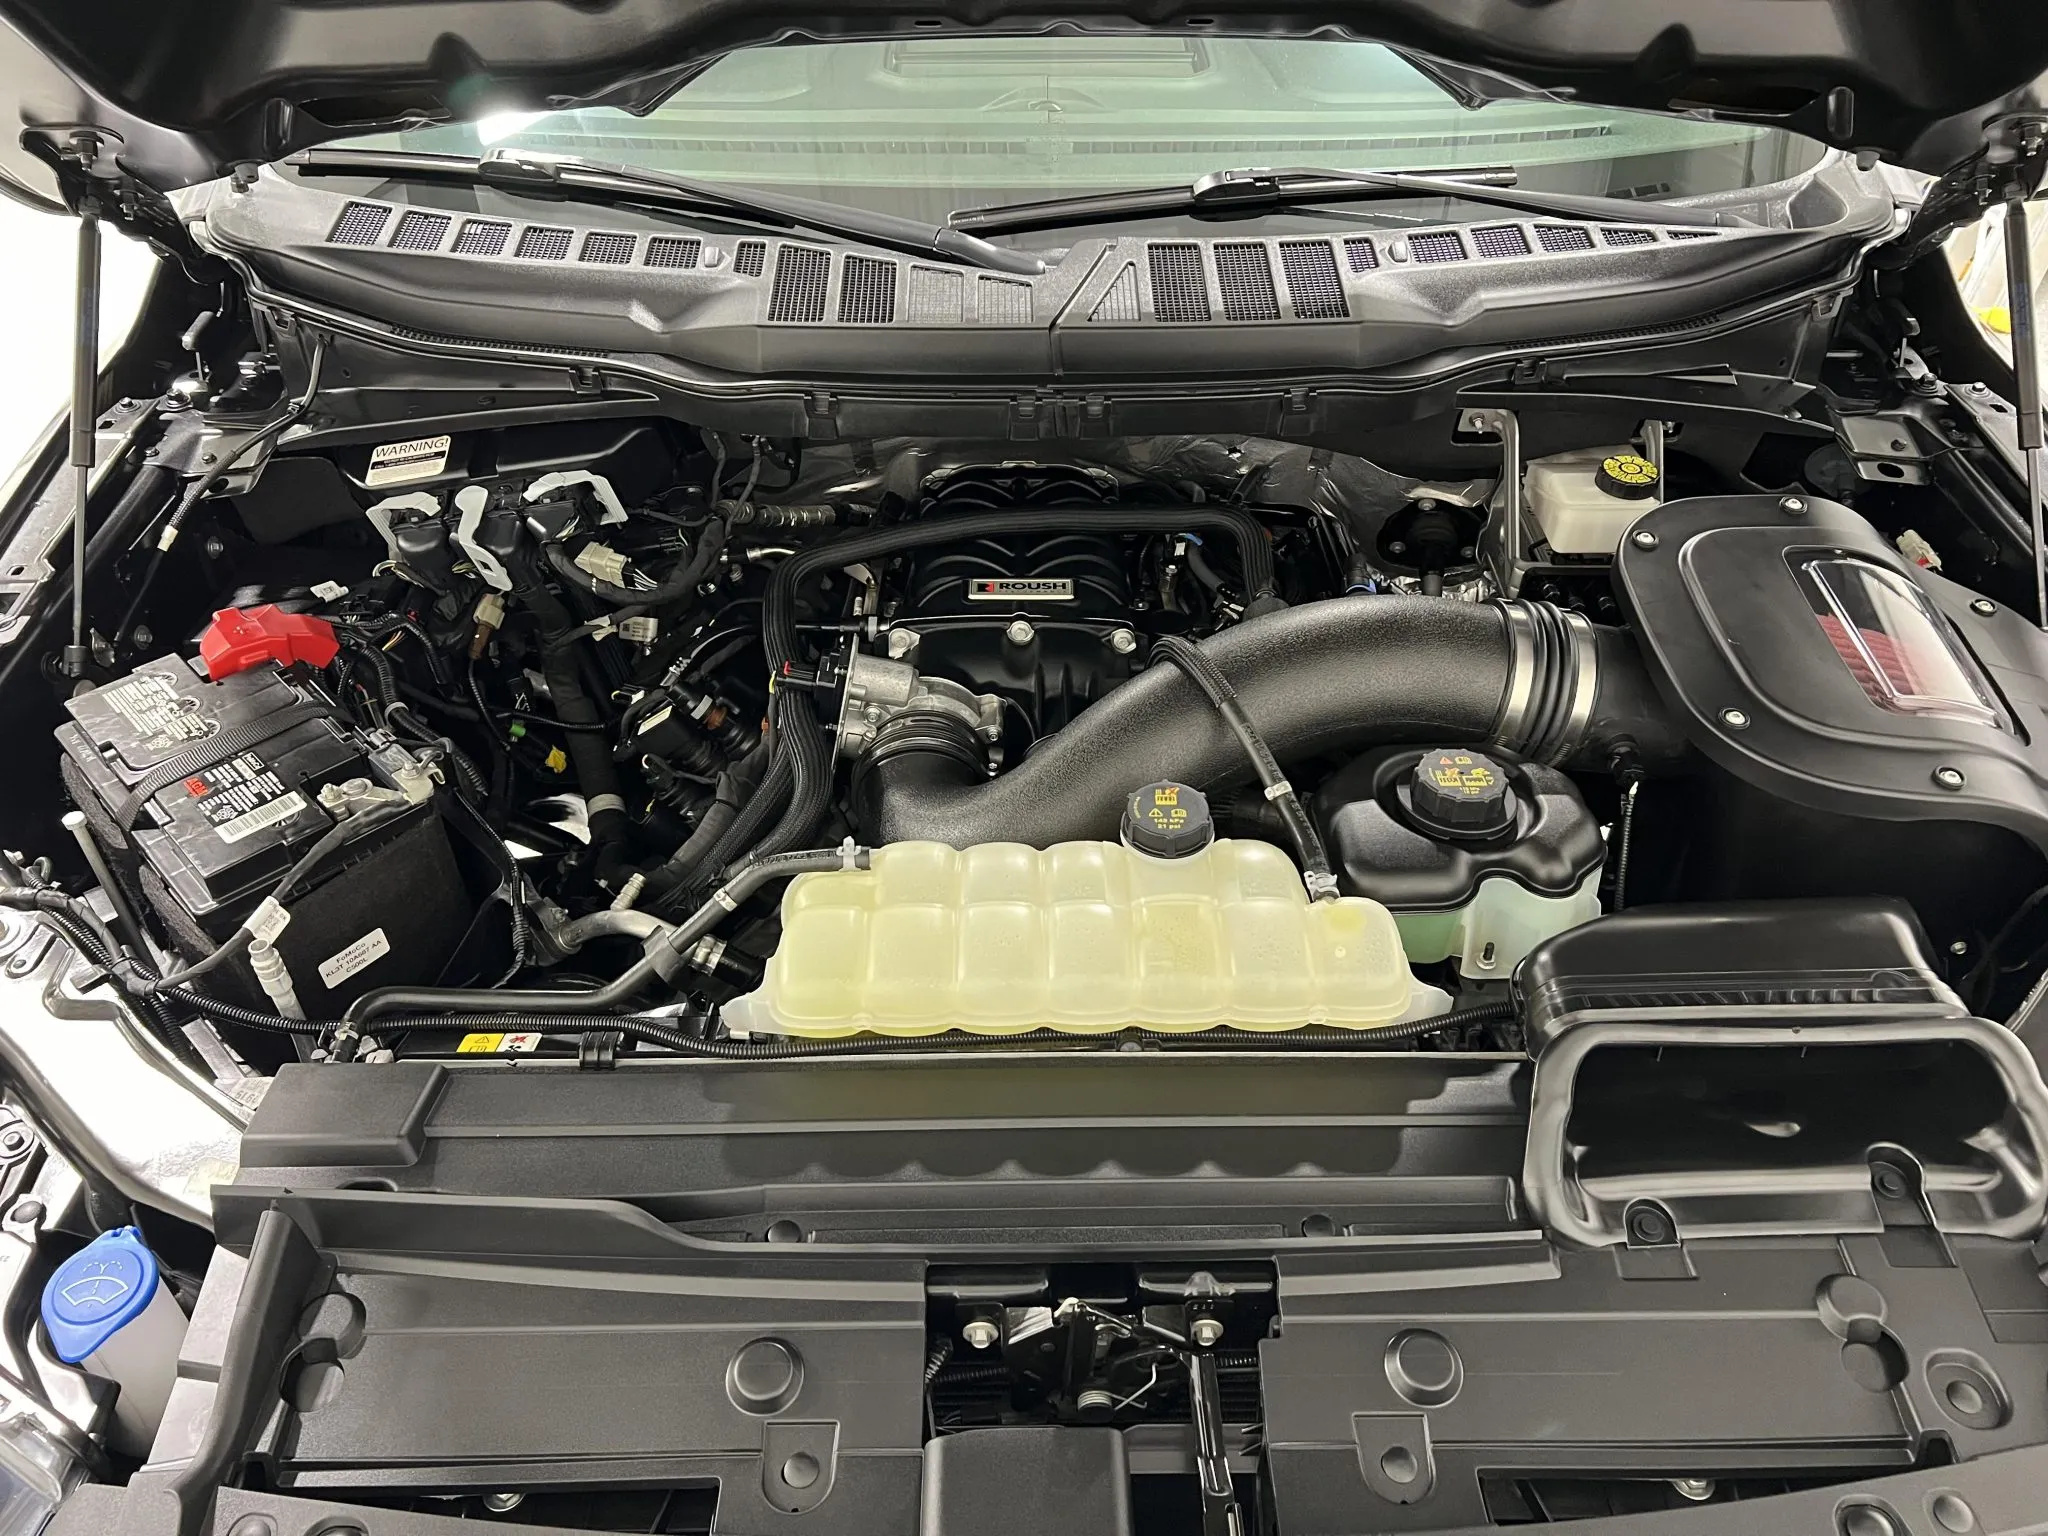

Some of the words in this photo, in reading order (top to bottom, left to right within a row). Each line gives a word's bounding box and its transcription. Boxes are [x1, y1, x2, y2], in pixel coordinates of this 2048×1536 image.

[375, 437, 449, 458] WARNING!
[999, 582, 1067, 590] ROUSH
[336, 942, 366, 964] FoMoCo
